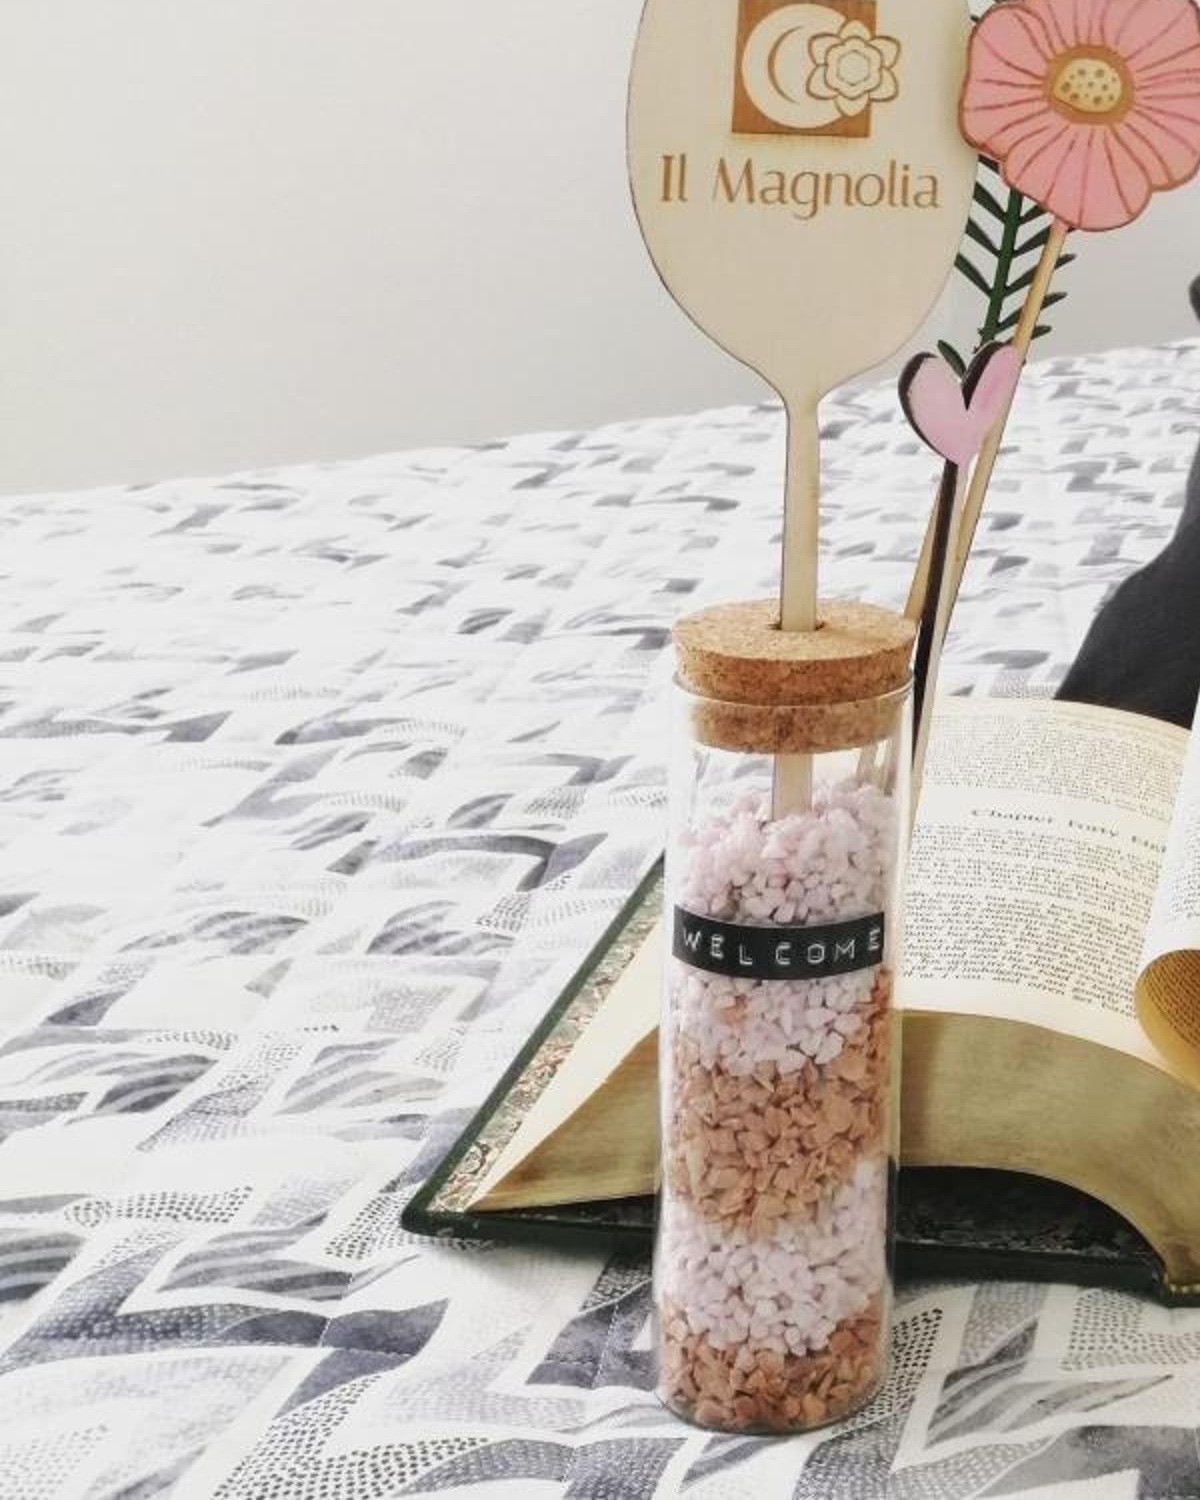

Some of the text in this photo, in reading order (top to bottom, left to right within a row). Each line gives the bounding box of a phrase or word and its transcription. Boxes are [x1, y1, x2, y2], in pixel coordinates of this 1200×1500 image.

[658, 153, 941, 220] Il Magnolia
[682, 927, 881, 966] WELCOME
